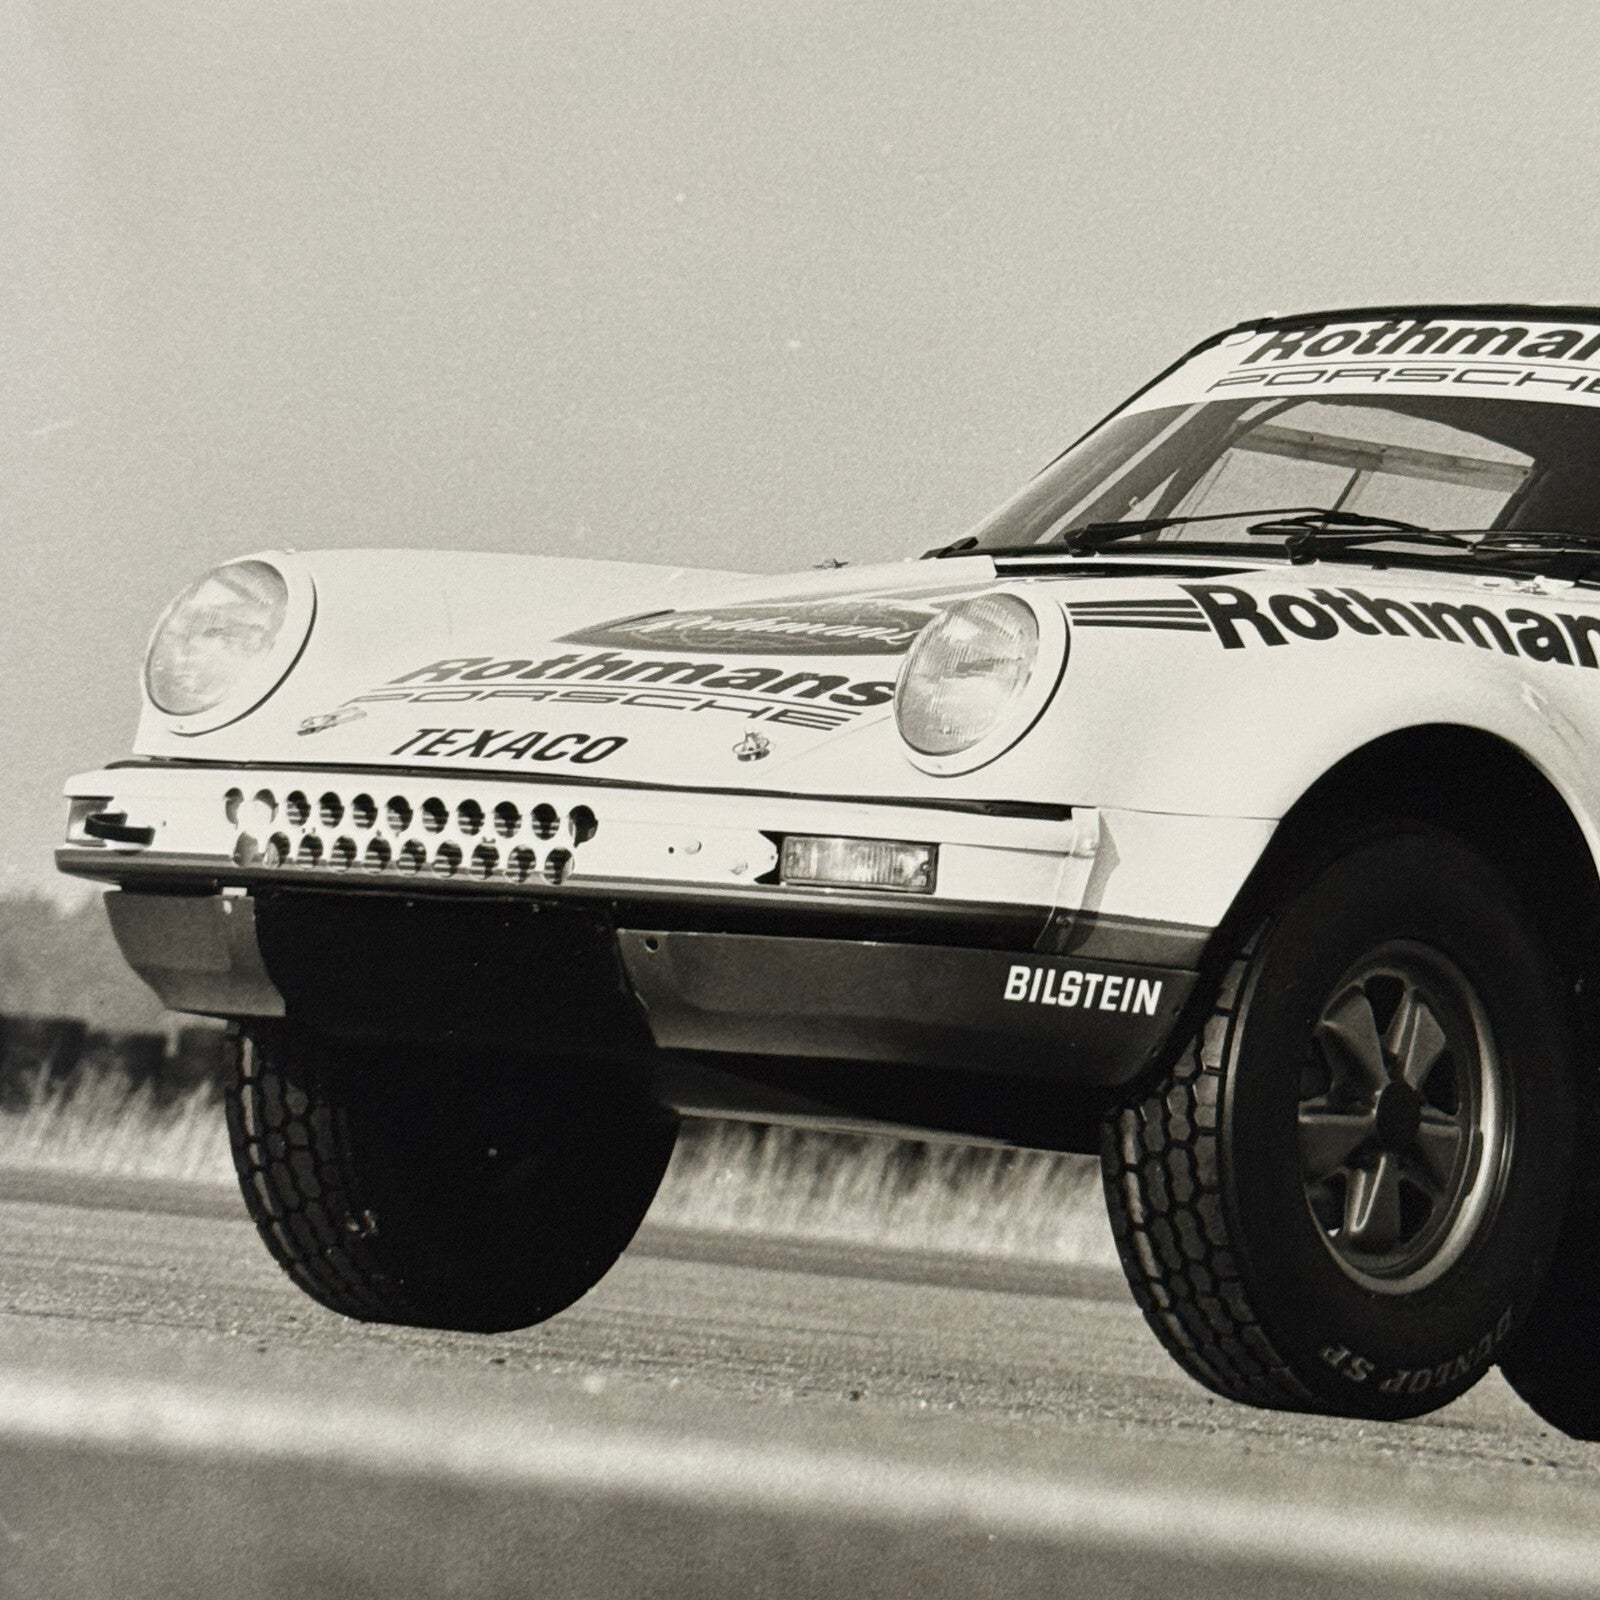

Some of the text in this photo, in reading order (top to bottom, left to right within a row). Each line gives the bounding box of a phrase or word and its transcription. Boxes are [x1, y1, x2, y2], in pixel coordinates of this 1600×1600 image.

[386, 653, 896, 706] Rothmans
[337, 690, 850, 731] PORSCHE
[390, 728, 628, 764] TEXACO
[1003, 965, 1163, 1016] BILSTEIN
[1320, 1344, 1376, 1383] SP
